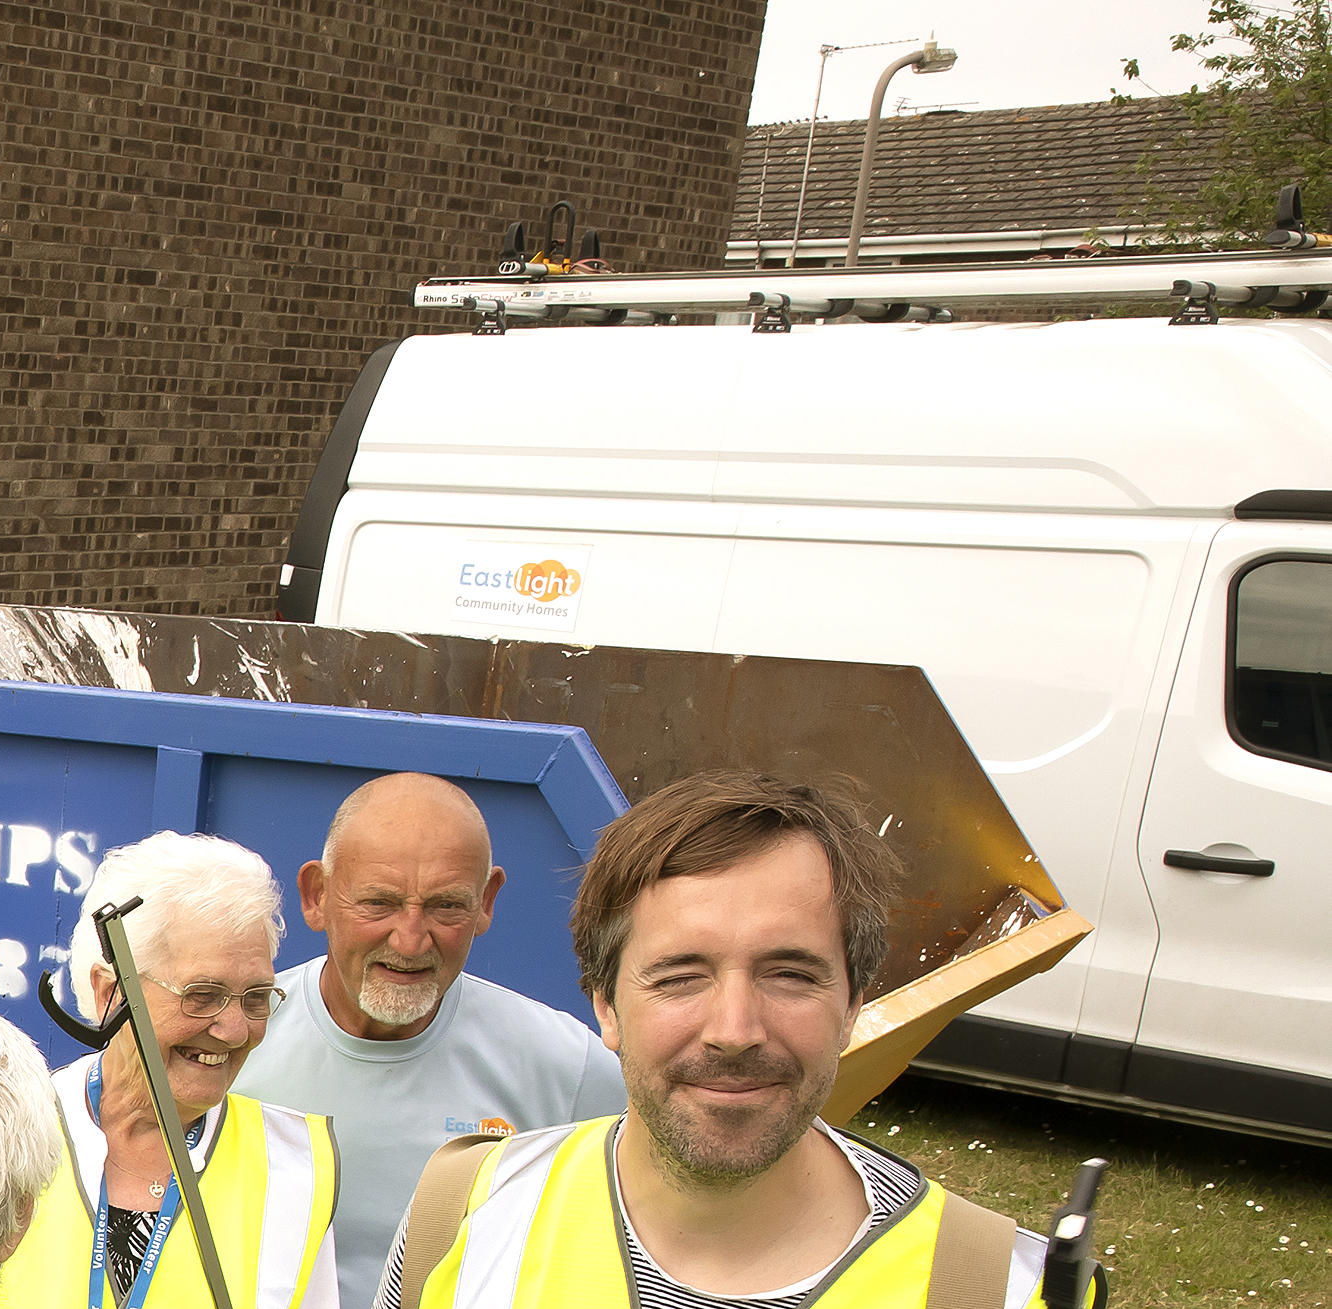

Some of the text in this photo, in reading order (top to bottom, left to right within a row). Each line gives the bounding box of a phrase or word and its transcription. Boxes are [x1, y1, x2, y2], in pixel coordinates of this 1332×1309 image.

[423, 294, 448, 303] Rhino
[459, 561, 576, 599] Eastlight
[455, 596, 569, 618] Community Homes
[92, 1207, 107, 1270] Volunteer
[142, 1215, 172, 1275] Volunteer
